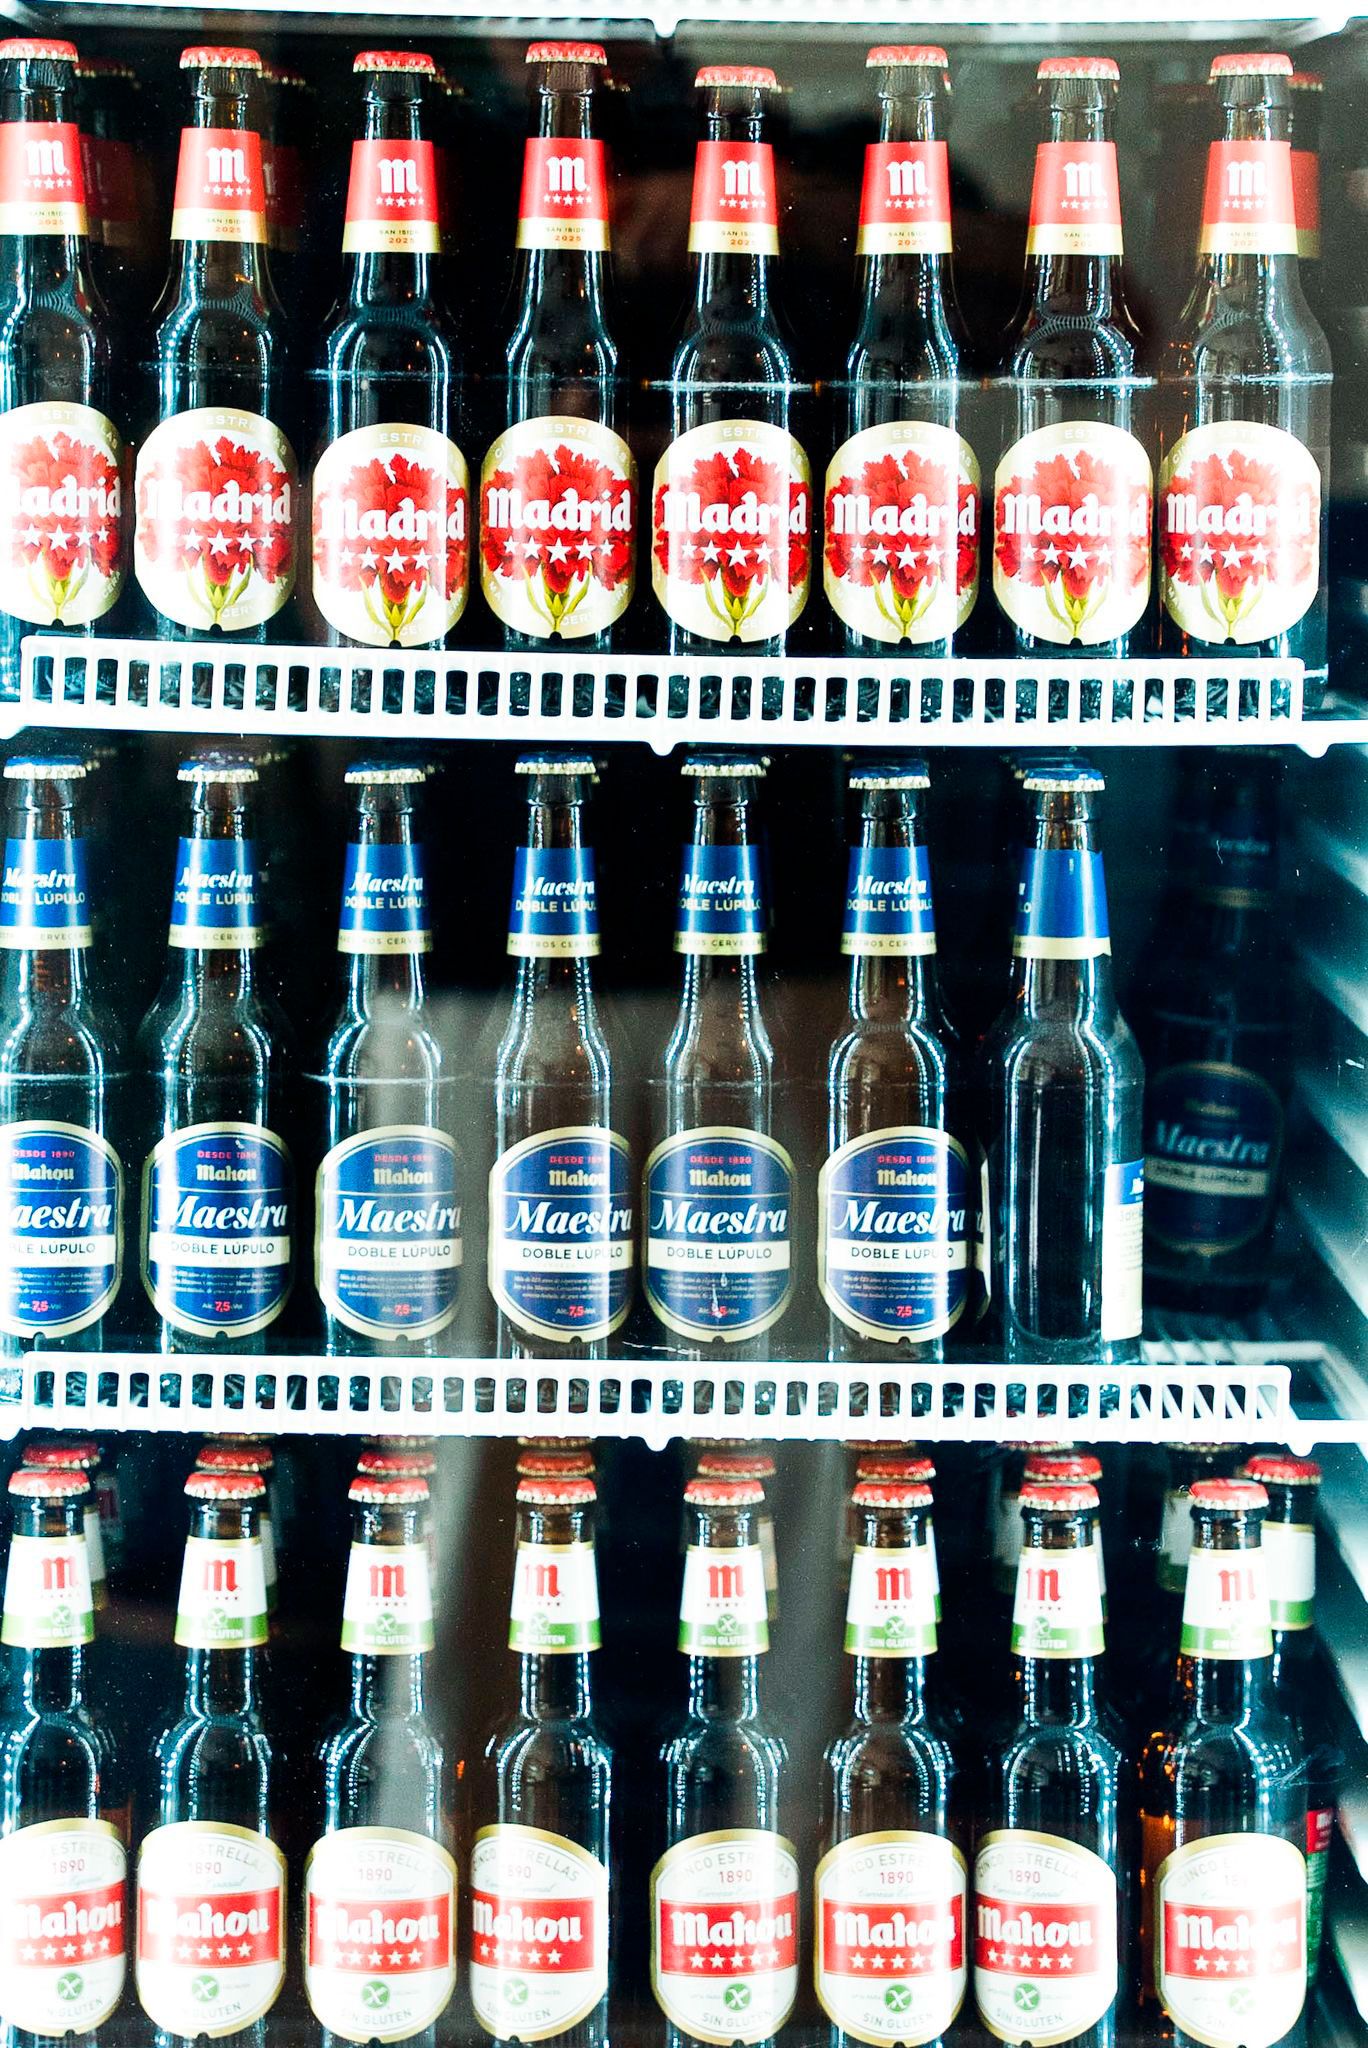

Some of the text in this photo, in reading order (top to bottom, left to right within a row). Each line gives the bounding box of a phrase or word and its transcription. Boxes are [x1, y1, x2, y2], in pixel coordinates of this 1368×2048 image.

[554, 236, 582, 244] 2025
[730, 239, 756, 248] 202
[486, 487, 630, 532] Madrid
[1002, 492, 1147, 537] Madrd
[1167, 491, 1311, 537] Madrd
[3, 867, 77, 889] Maestra
[177, 867, 254, 889] Maestra
[348, 871, 424, 893] Maestra
[520, 876, 596, 898] Maestra
[680, 873, 756, 895] Maestra
[851, 873, 927, 895] Maestra
[345, 895, 424, 909] DOBLE LÚPU
[515, 898, 597, 913] DOBLE LÚPU
[11, 1149, 47, 1159] DESDE
[198, 1150, 232, 1160] DESDE
[374, 1154, 408, 1164] DESDE
[549, 1155, 584, 1164] DESDE
[689, 1155, 724, 1165] DESDE
[877, 1155, 912, 1165] DESDE
[9, 1163, 74, 1181] Mahou
[196, 1163, 258, 1182] Mahou
[373, 1167, 434, 1185] Mahou
[548, 1168, 608, 1187] Mahou
[688, 1169, 752, 1187] Mahou
[877, 1169, 938, 1187] Mahou
[10, 1196, 113, 1230] aestra
[155, 1195, 288, 1230] Maestra
[336, 1199, 462, 1233] Maestra
[506, 1199, 632, 1234] Maestra
[651, 1199, 787, 1235] Maestra
[830, 1199, 966, 1234] Maestra
[40, 1240, 96, 1255] LÚPULO
[172, 1239, 275, 1256] DOBLE LÚPULO
[347, 1243, 452, 1258] DOBLE LÚPULO
[521, 1246, 578, 1260] DOBLE
[666, 1243, 773, 1261] DOBLE LÚPULO
[851, 1244, 955, 1260] DOBLE LÚPUO
[215, 1301, 231, 1314] 7,5
[394, 1303, 411, 1316] 7,5
[569, 1305, 585, 1318] 7,5
[896, 1305, 913, 1318] 7,5
[51, 1858, 86, 1874] 1890
[358, 1868, 393, 1882] 1890
[502, 1864, 532, 1880] 890
[718, 1870, 753, 1884] 1890
[878, 1870, 914, 1885] 1890
[1008, 1867, 1041, 1884] 1890
[316, 1905, 439, 1945] Mahou
[473, 1898, 583, 1943] Mahou
[671, 1909, 794, 1948] Mahou
[832, 1909, 957, 1949] Mahou
[978, 1905, 1094, 1948] Mahou
[1175, 1912, 1298, 1951] Mahu
[362, 2007, 413, 2027] GLUTEN
[700, 2010, 724, 2029] SIN
[862, 2010, 885, 2030] SIN
[995, 2006, 1064, 2031] SIN GLUTEN
